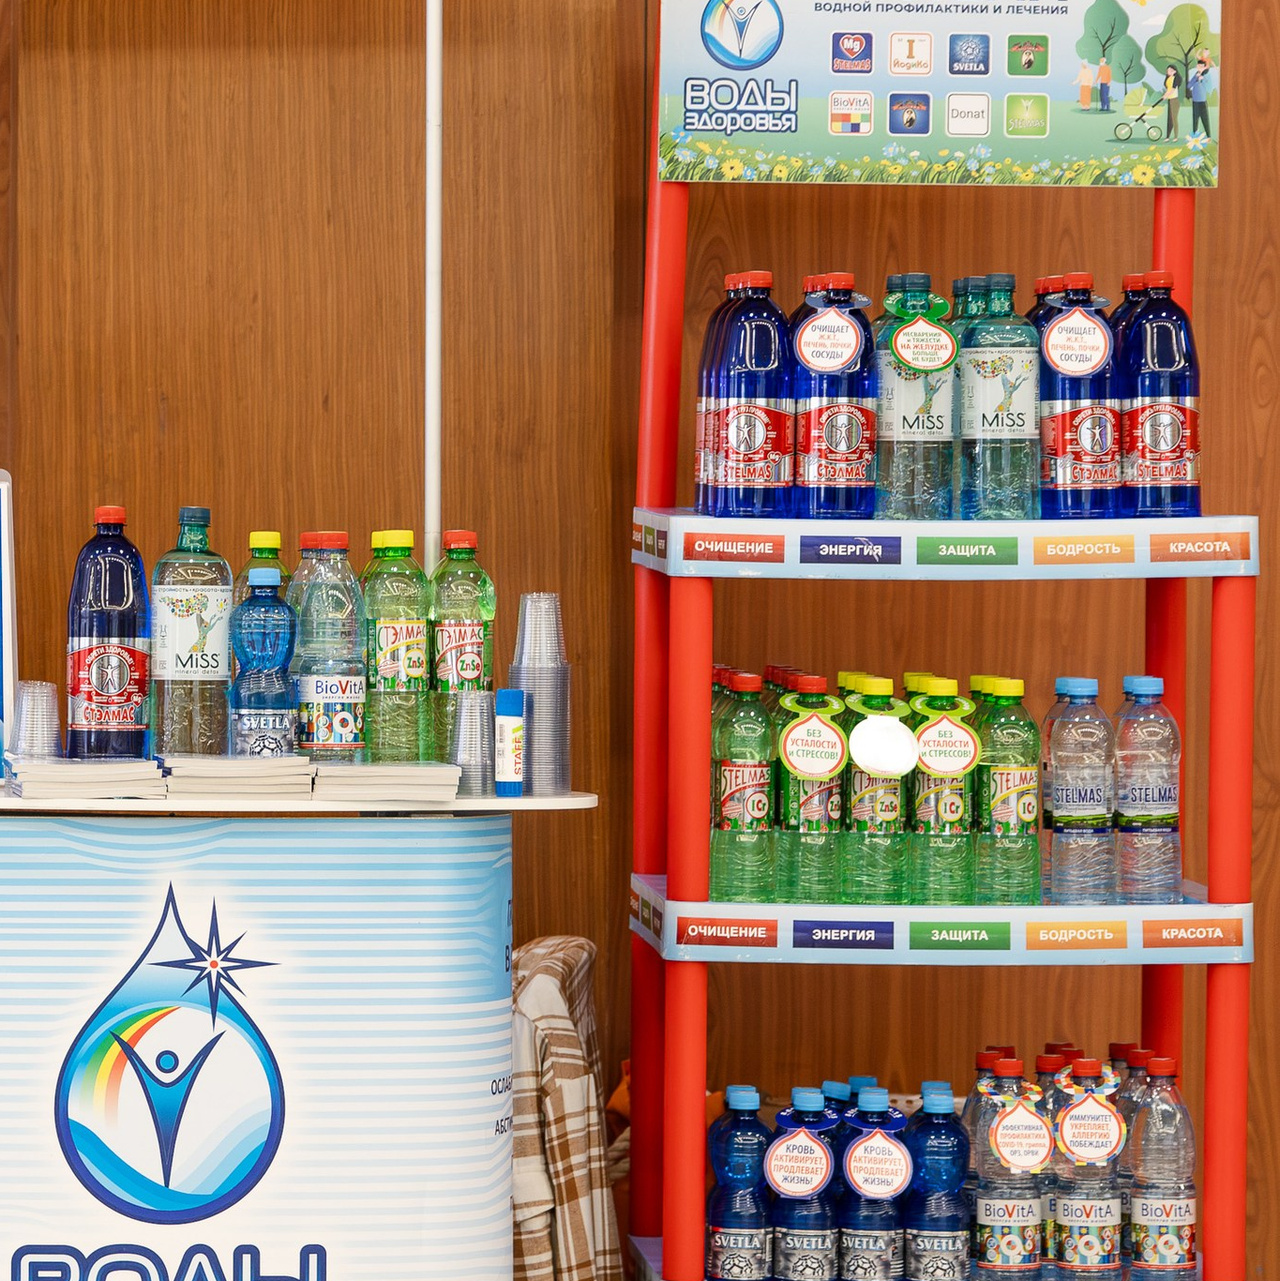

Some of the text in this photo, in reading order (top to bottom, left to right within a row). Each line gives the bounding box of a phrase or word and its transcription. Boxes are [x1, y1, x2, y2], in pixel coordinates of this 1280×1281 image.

[814, 1, 1068, 15] ВОДНОЙ ПРОФИЛАКТИКИ И ЛЕЧЕНИЯ
[834, 59, 871, 70] STELMAS
[953, 62, 985, 71] SVETLA
[685, 79, 798, 112] ВОДЫ
[951, 109, 985, 119] Donat
[811, 325, 849, 333] ОЧИЩАЕТ
[1057, 326, 1096, 336] ОЧИЩАЕТ
[811, 351, 843, 359] СОСУДЫ
[1060, 353, 1092, 362] СОСУДЫ
[902, 415, 944, 430] MiSS
[982, 413, 1025, 427] MiSS
[724, 464, 772, 480] STELMAS
[817, 463, 866, 478] СТЭЛМАС
[1138, 464, 1187, 478] STELMAS
[695, 541, 1230, 557] ОЧИЩЕНИЕ ЭНЕРГИЯ ЗАЩИТА БОДРОСТЬ КРАСОТА
[378, 624, 426, 651] СТЭЛМАС
[436, 627, 482, 654] СТЭЛМАС
[175, 653, 219, 668] MiSS
[460, 660, 480, 671] ZnSe
[315, 680, 364, 694] BioVitA
[83, 705, 135, 722] СТЭЛМАС
[243, 716, 290, 729] SVETLA
[807, 729, 821, 737] БЕЗ
[938, 730, 953, 739] БЕЗ
[791, 738, 837, 749] УСТАЛОСТИ
[922, 739, 969, 749] УСТАЛОСТИ
[796, 749, 838, 760] СТРЕССОВ!
[928, 749, 971, 758] СТРЕССОВ!
[722, 768, 770, 791] STELMAS
[992, 770, 1038, 804] STELMAS
[1055, 786, 1103, 804] STELMAS
[1131, 786, 1177, 803] STELMAS
[688, 925, 1223, 942] ОЧИЩЕНИЕ ЭНЕРГИЯ ЗАЩИТА БОДРОСТЬ КРАСОТА
[1069, 1114, 1112, 1122] ИММУНИТЕТ
[1070, 1123, 1111, 1132] УКРЕПЛЯЕТ,
[1072, 1131, 1111, 1139] АЛЛЕРГИЮ
[786, 1144, 815, 1154] КРОВЬ
[1069, 1140, 1112, 1148] ПОБЕЖДАЕТ
[863, 1146, 893, 1156] КРОВЬ
[773, 1154, 824, 1166] АКТИВИРУЕТ,
[853, 1155, 904, 1167] АКТИВИРУЕТ,
[773, 1164, 824, 1175] ПРОДЛЕВАЕТ
[853, 1166, 904, 1177] ПРОДЛЕВАЕТ
[781, 1175, 813, 1185] ЖИЗНЬ!
[862, 1177, 894, 1186] ЖИЗНЬ!
[715, 1234, 760, 1249] SVETLA
[786, 1235, 832, 1250] SVETLA
[842, 1235, 885, 1250] SVETLA
[917, 1236, 963, 1250] SVETLA
